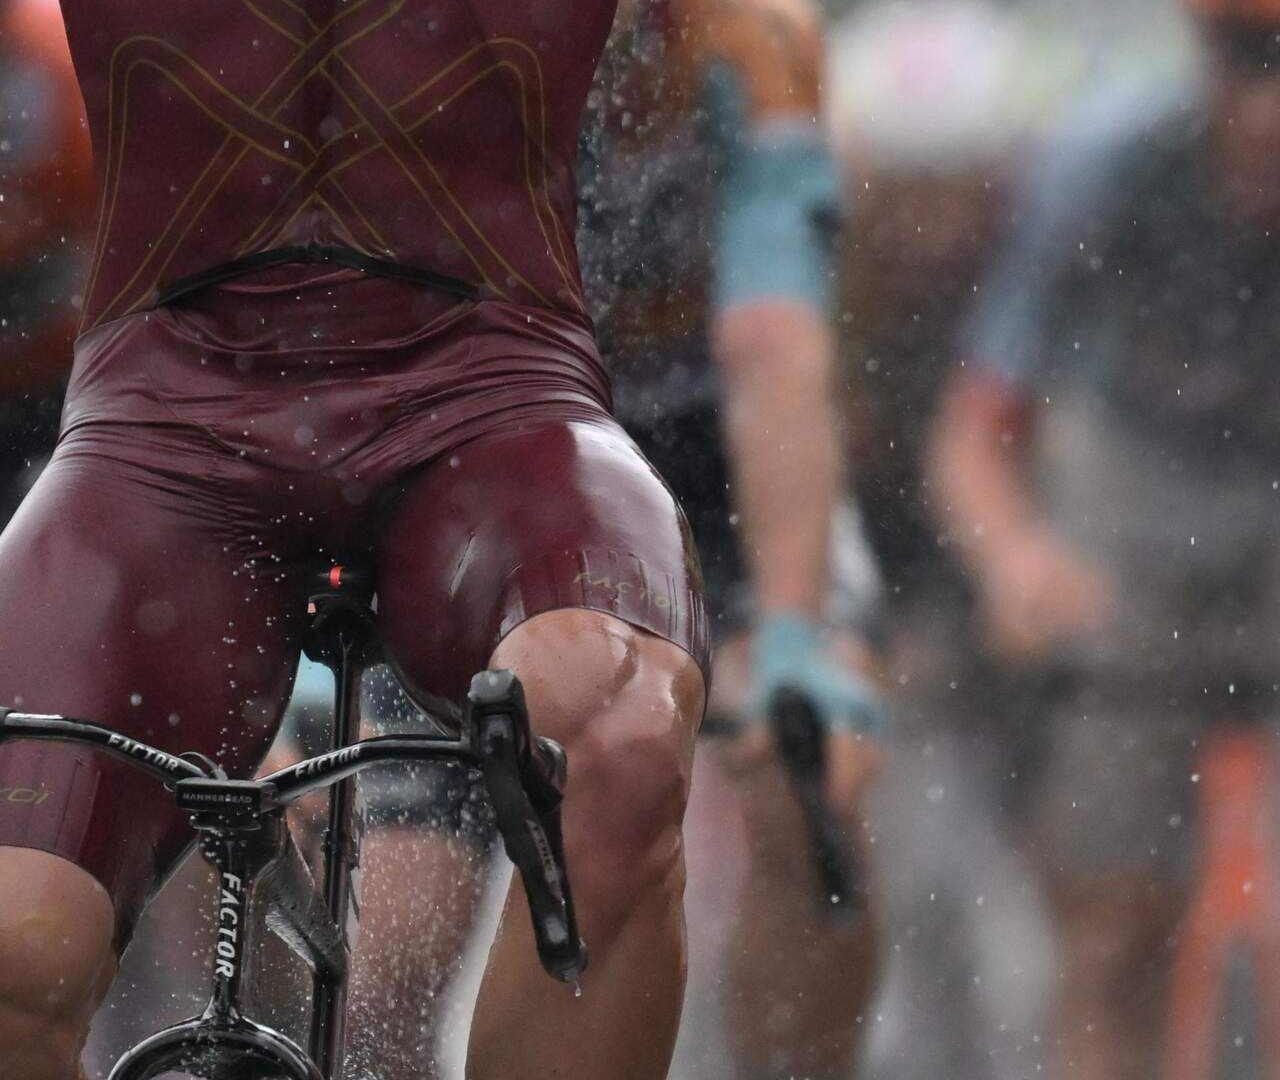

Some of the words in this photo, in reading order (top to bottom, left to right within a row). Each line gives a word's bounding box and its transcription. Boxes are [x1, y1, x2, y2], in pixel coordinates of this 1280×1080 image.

[108, 733, 179, 771] FACTOR
[294, 745, 362, 778] FACTOR
[215, 871, 241, 978] FACTOR
